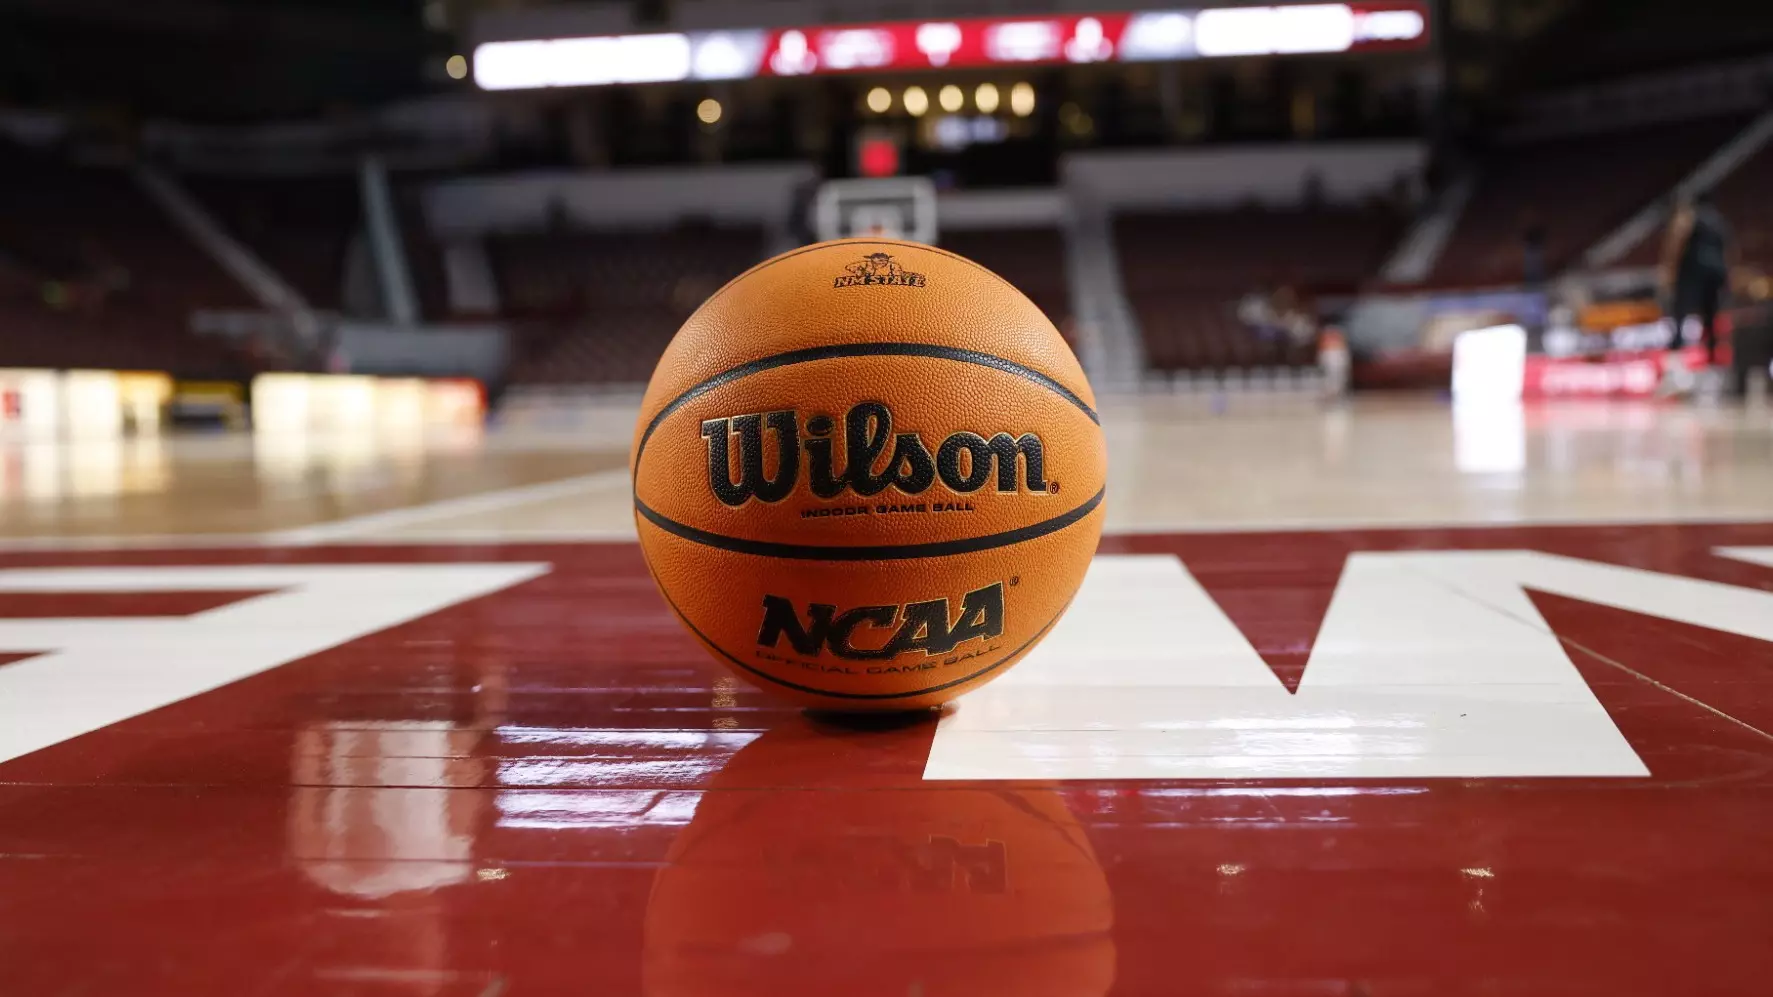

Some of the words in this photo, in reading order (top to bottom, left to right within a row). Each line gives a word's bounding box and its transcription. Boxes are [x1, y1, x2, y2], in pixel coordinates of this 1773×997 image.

[701, 402, 1050, 509] Wilson
[801, 507, 868, 519] INDOOR
[874, 504, 926, 515] GAME
[932, 502, 974, 513] BALL
[757, 581, 1004, 660] NCAA
[866, 661, 937, 675] GAME
[943, 645, 1001, 666] BALL
